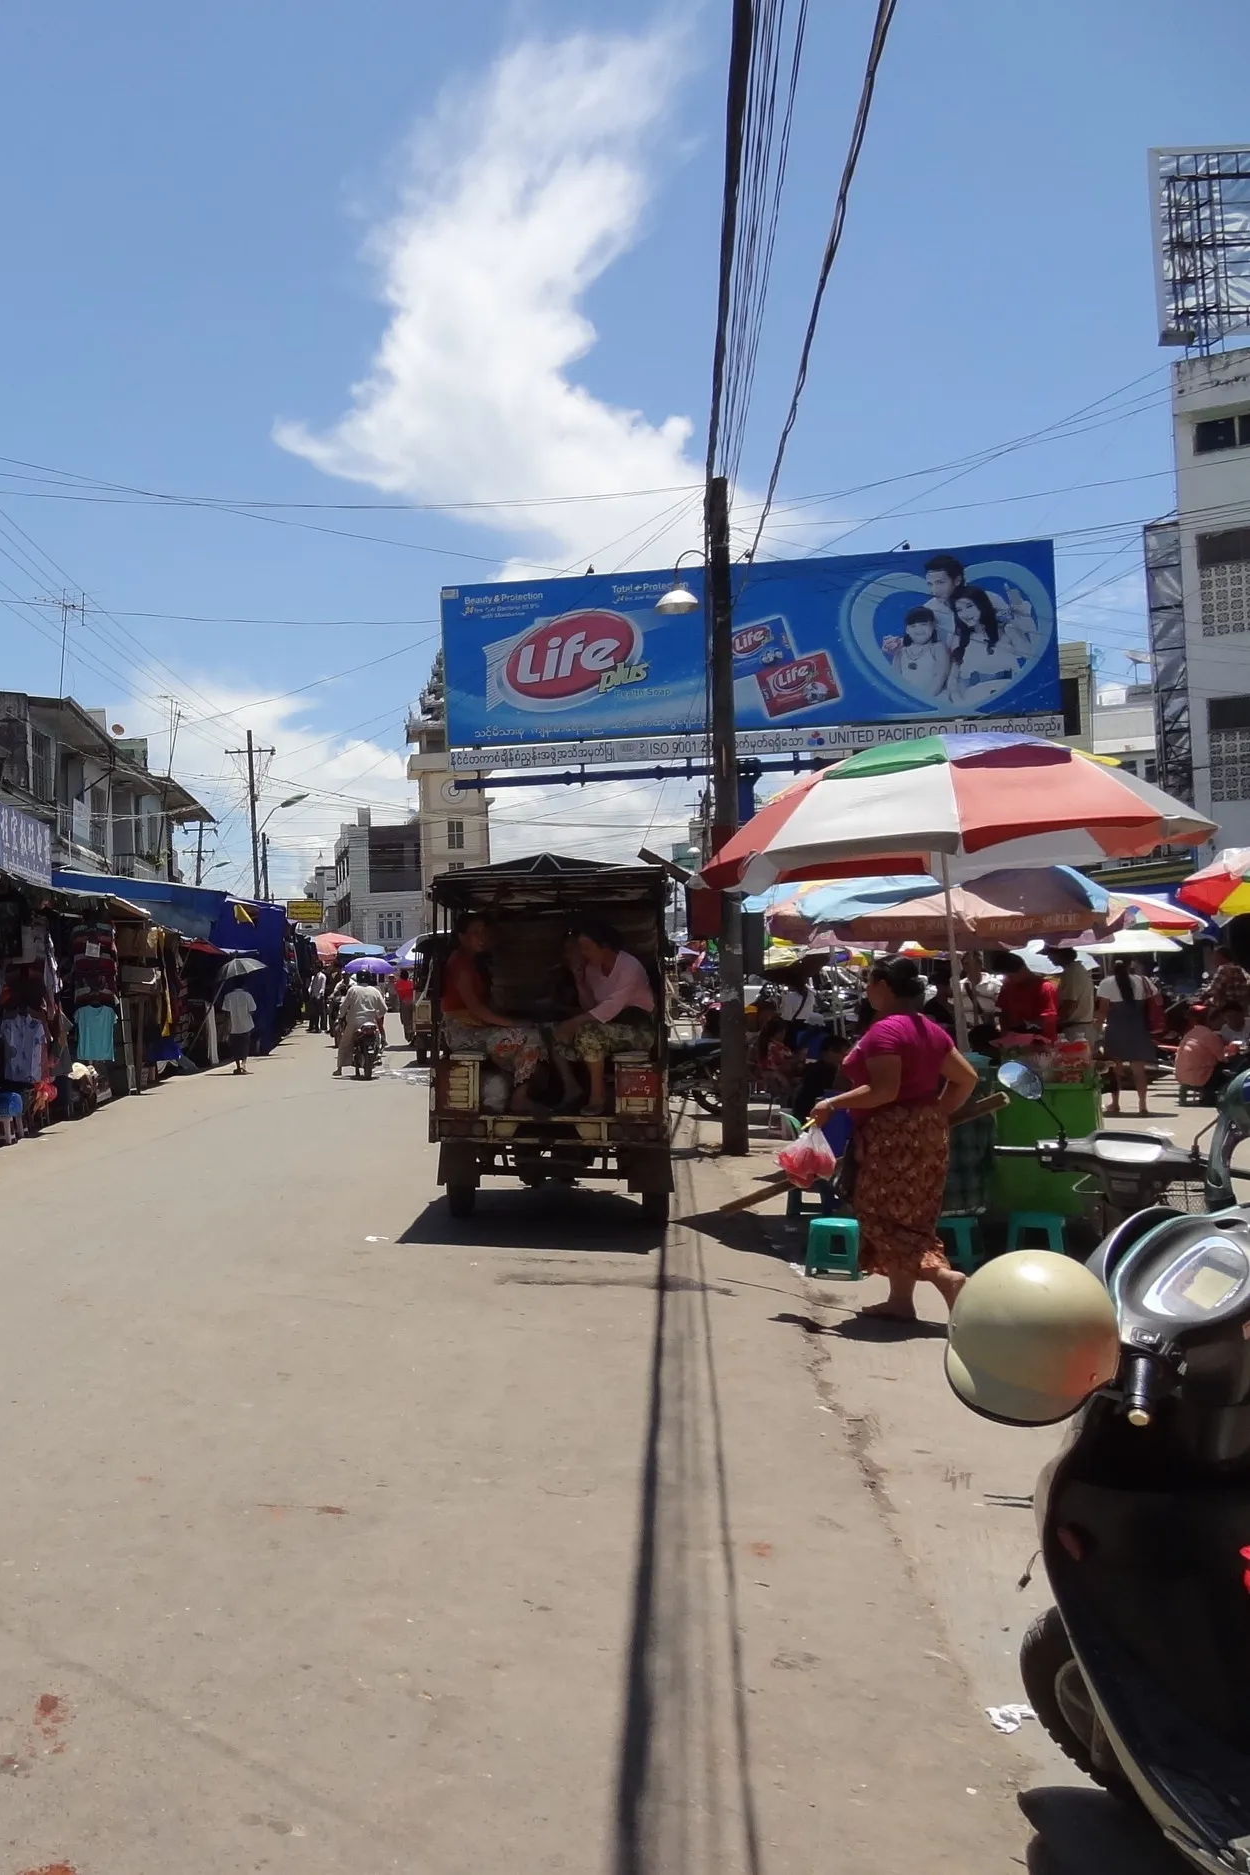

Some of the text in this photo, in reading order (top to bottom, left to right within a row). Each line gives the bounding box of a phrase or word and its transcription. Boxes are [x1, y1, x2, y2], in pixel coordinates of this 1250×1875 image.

[464, 591, 544, 606] Beauty & Protection
[612, 584, 632, 593] Total
[643, 582, 689, 592] Protecon
[734, 630, 765, 652] Life
[516, 632, 621, 684] Life
[598, 661, 650, 694] plus
[778, 664, 809, 687] Life
[615, 687, 671, 698] Health Soap
[650, 742, 669, 755] ISO
[829, 729, 874, 744] UNITED
[878, 726, 926, 741] PACIFIC
